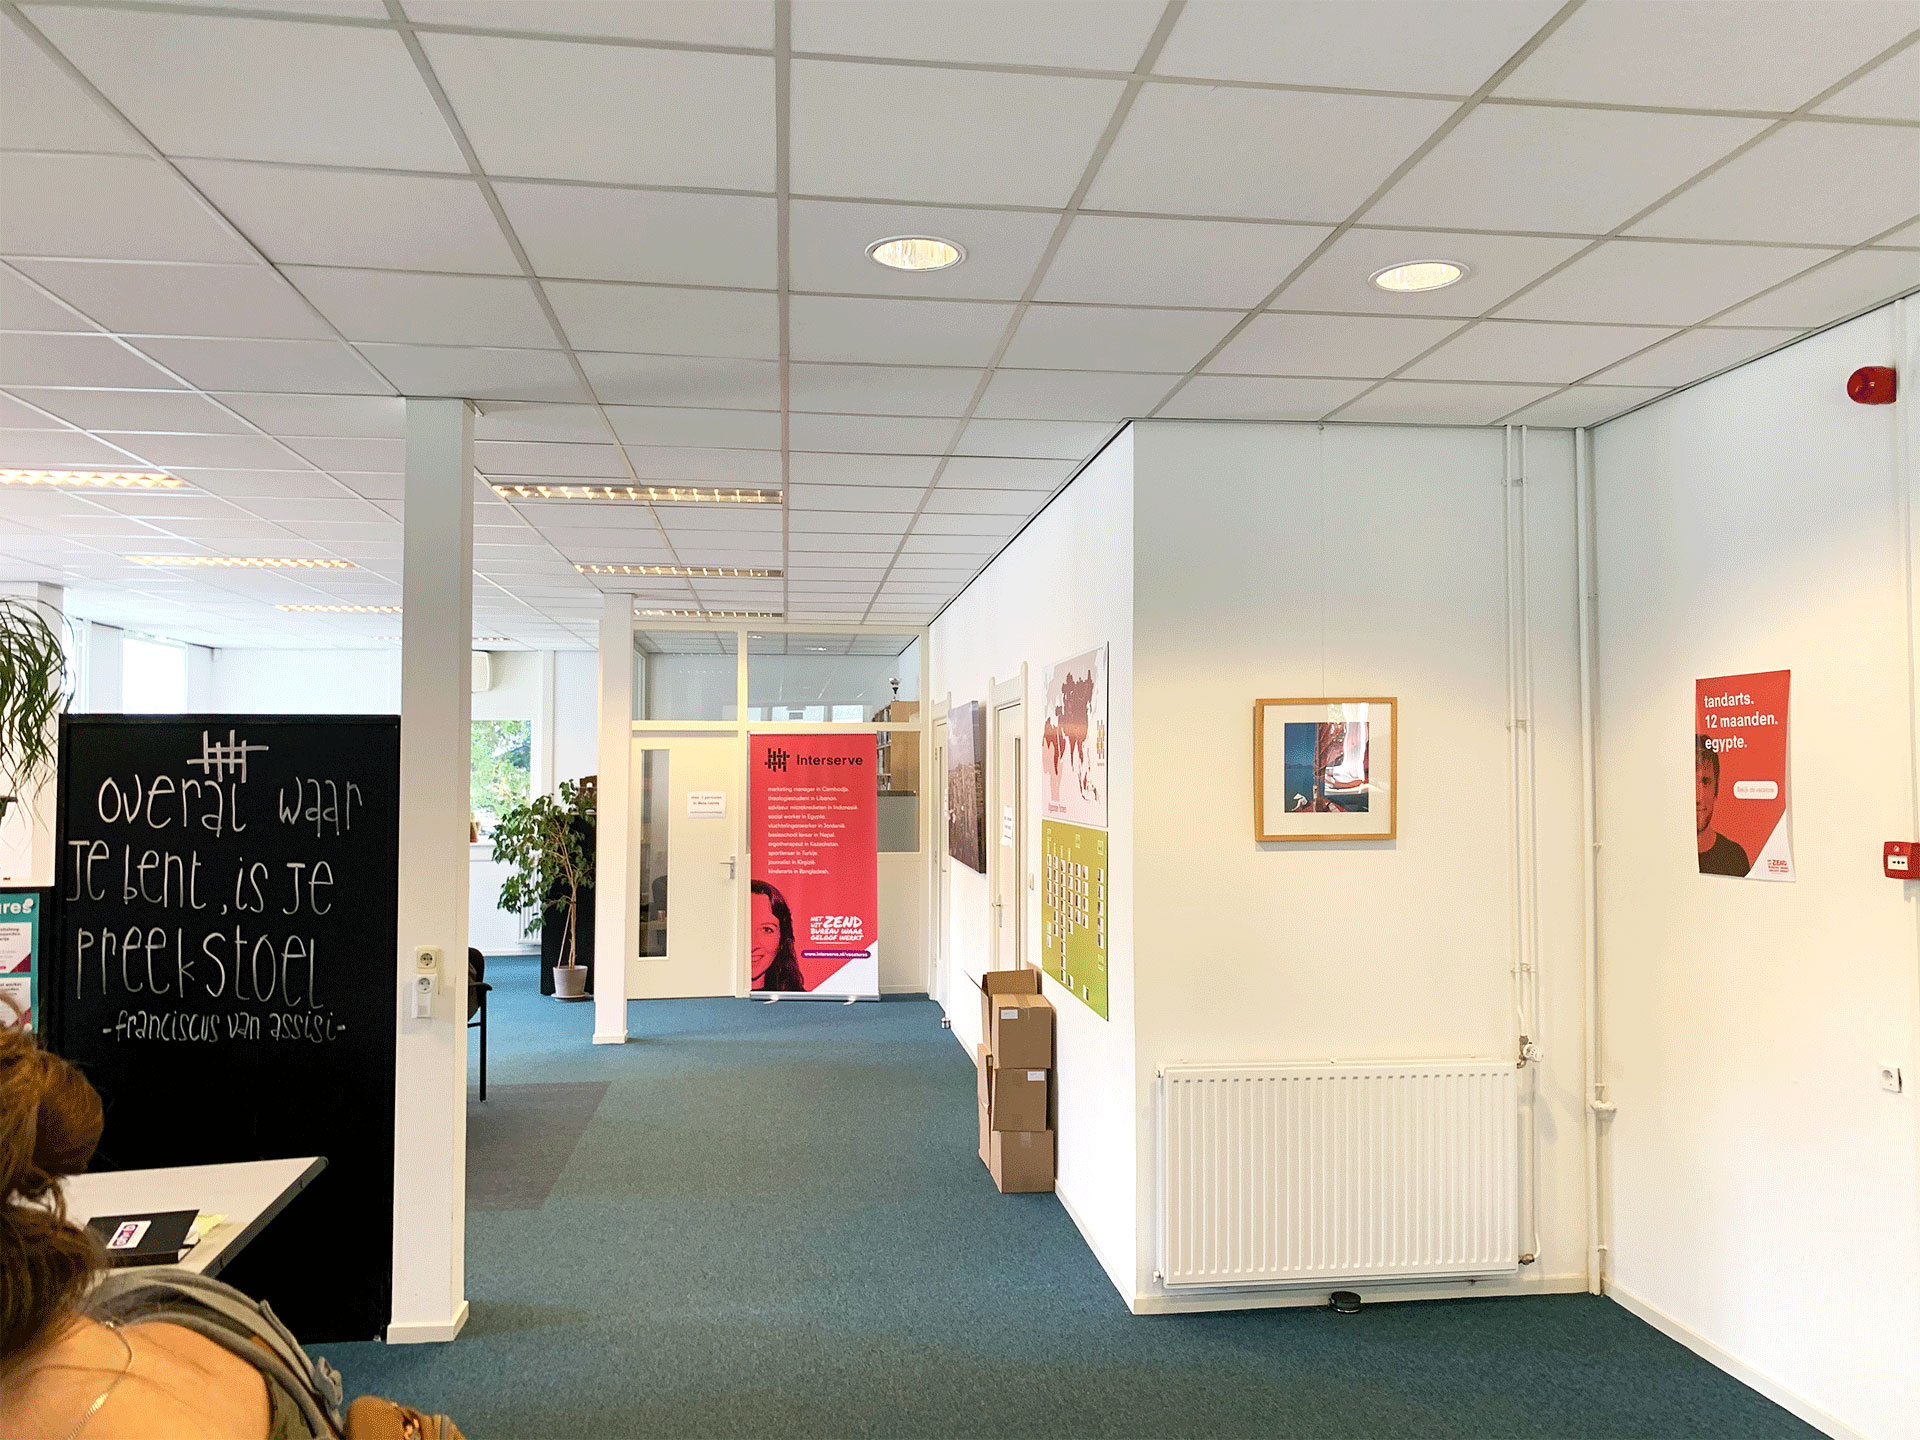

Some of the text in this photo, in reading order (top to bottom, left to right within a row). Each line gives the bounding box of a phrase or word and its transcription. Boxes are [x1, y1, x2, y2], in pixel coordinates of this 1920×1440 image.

[1704, 692, 1755, 708] tandarts.
[1705, 711, 1778, 728] 12 maanden.
[1705, 735, 1748, 753] egypte.
[796, 754, 863, 766] Interserve
[98, 773, 363, 838] overal waar
[823, 915, 863, 928] ZEND
[227, 1012, 260, 1040] van
